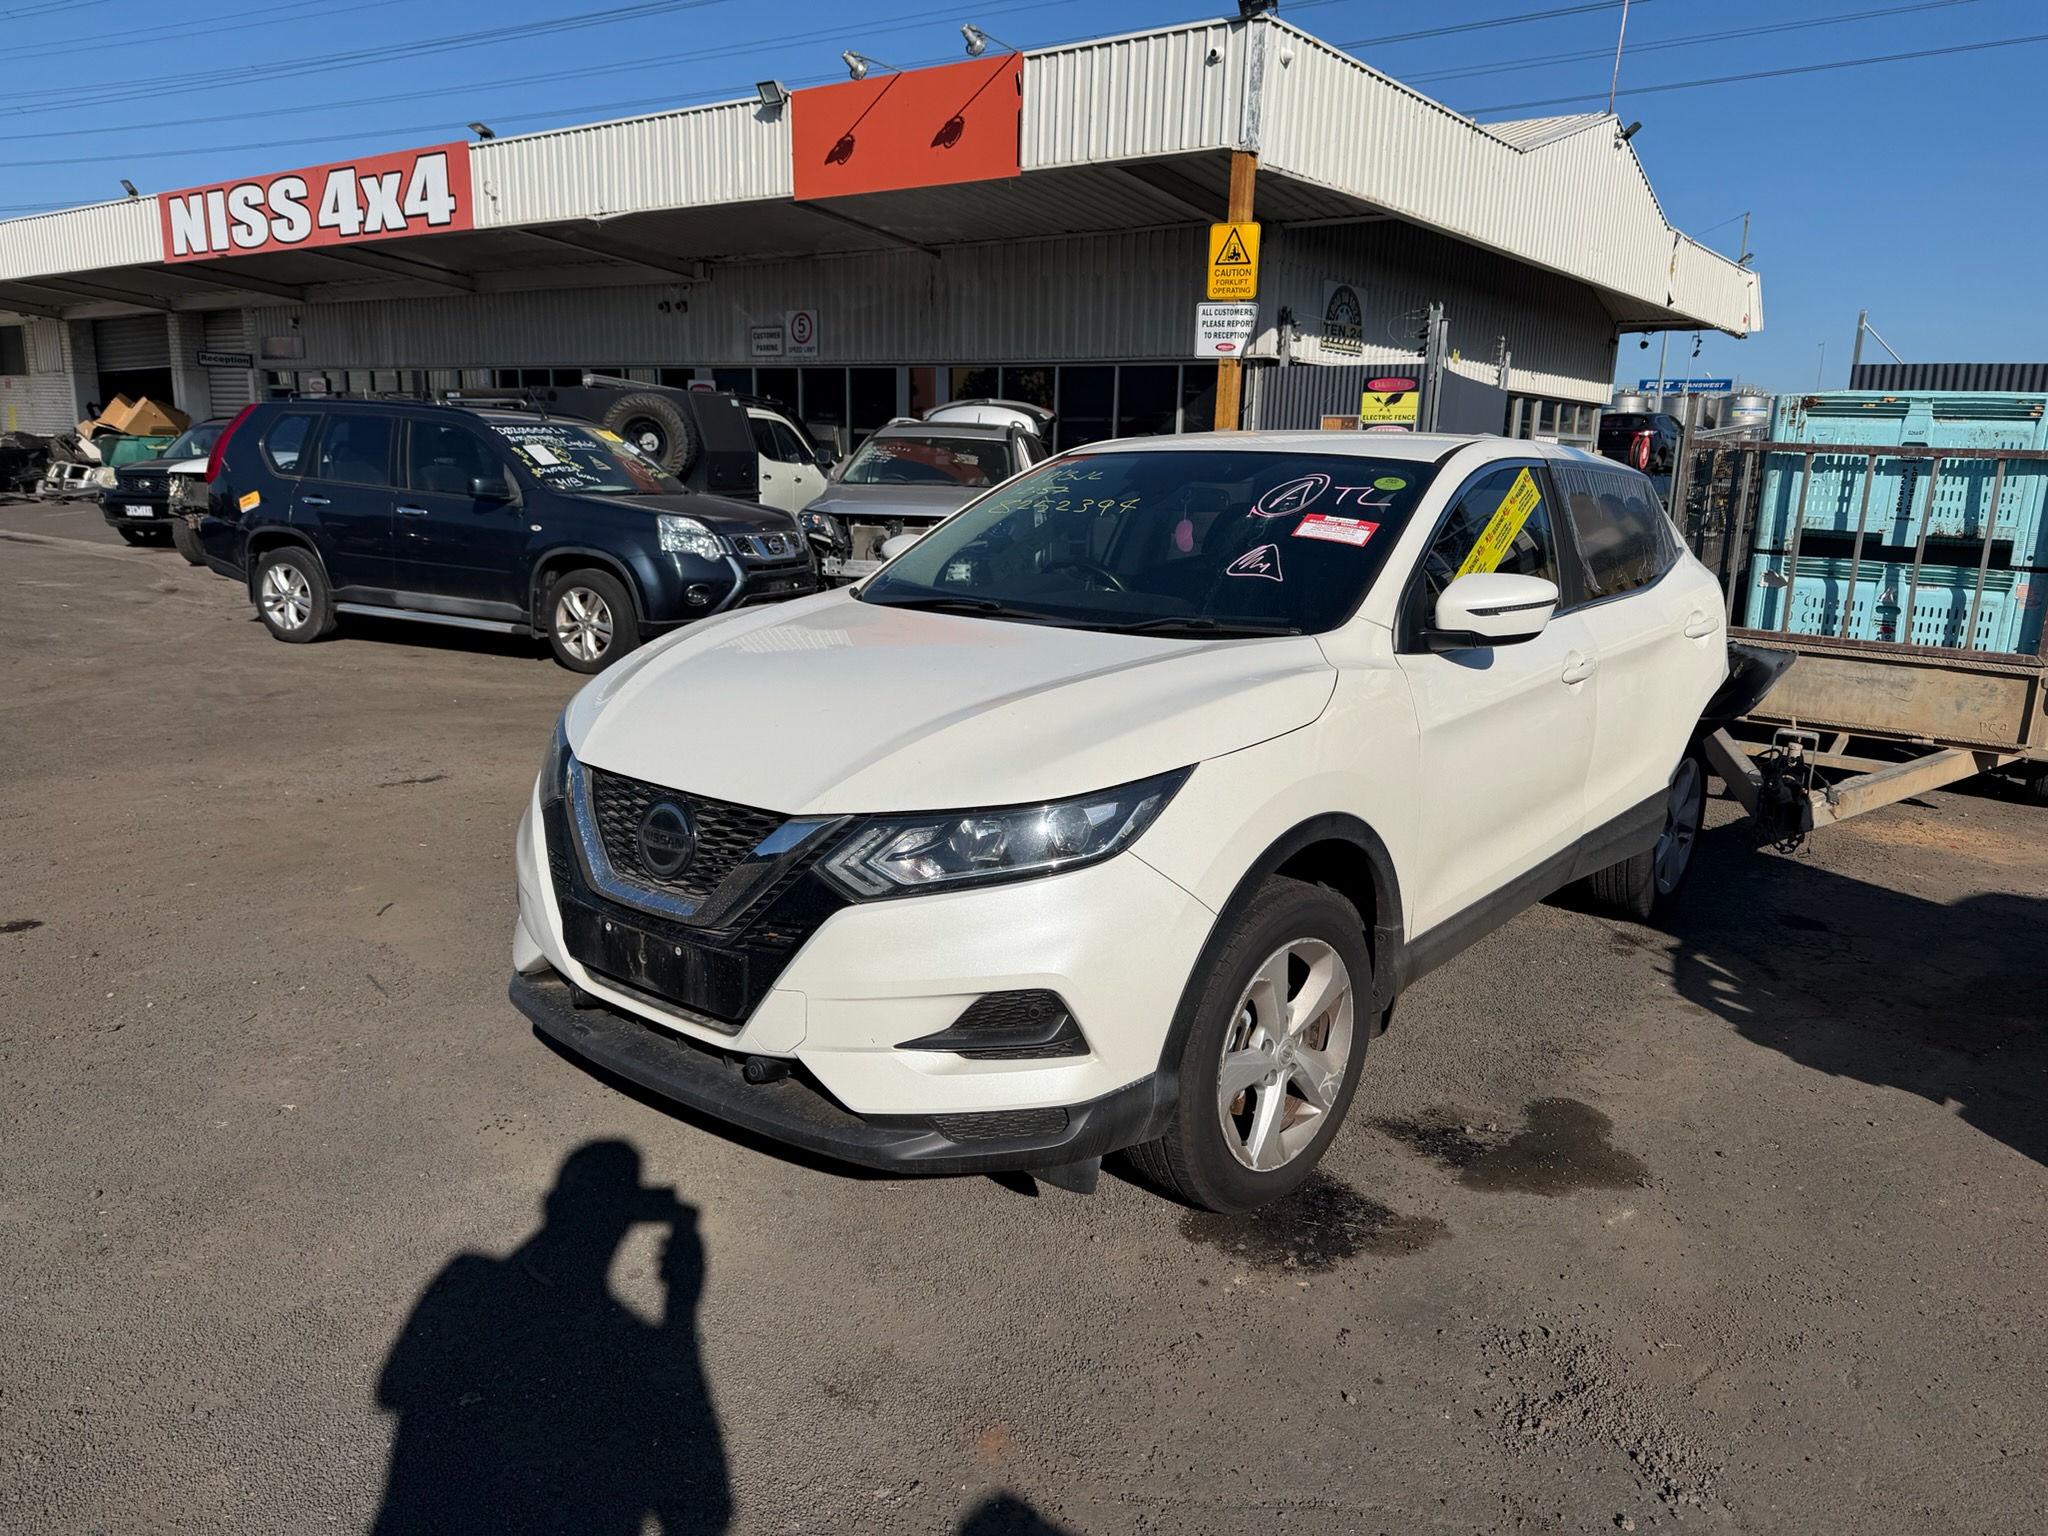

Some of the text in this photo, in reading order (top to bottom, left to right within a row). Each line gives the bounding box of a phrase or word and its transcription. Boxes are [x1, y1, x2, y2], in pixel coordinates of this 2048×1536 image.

[168, 151, 457, 257] NISS 4x4
[1214, 269, 1252, 277] CAUTION
[1201, 308, 1255, 317] ALL CUSTOMERS,
[798, 317, 806, 334] 5
[1201, 320, 1254, 328] PLEASE REPORT
[1323, 321, 1363, 339] TEN.24
[1204, 331, 1250, 340] TO RECEPTION
[756, 343, 779, 352] PARKING
[201, 354, 249, 364] Reception
[643, 829, 685, 850] NISSAN
